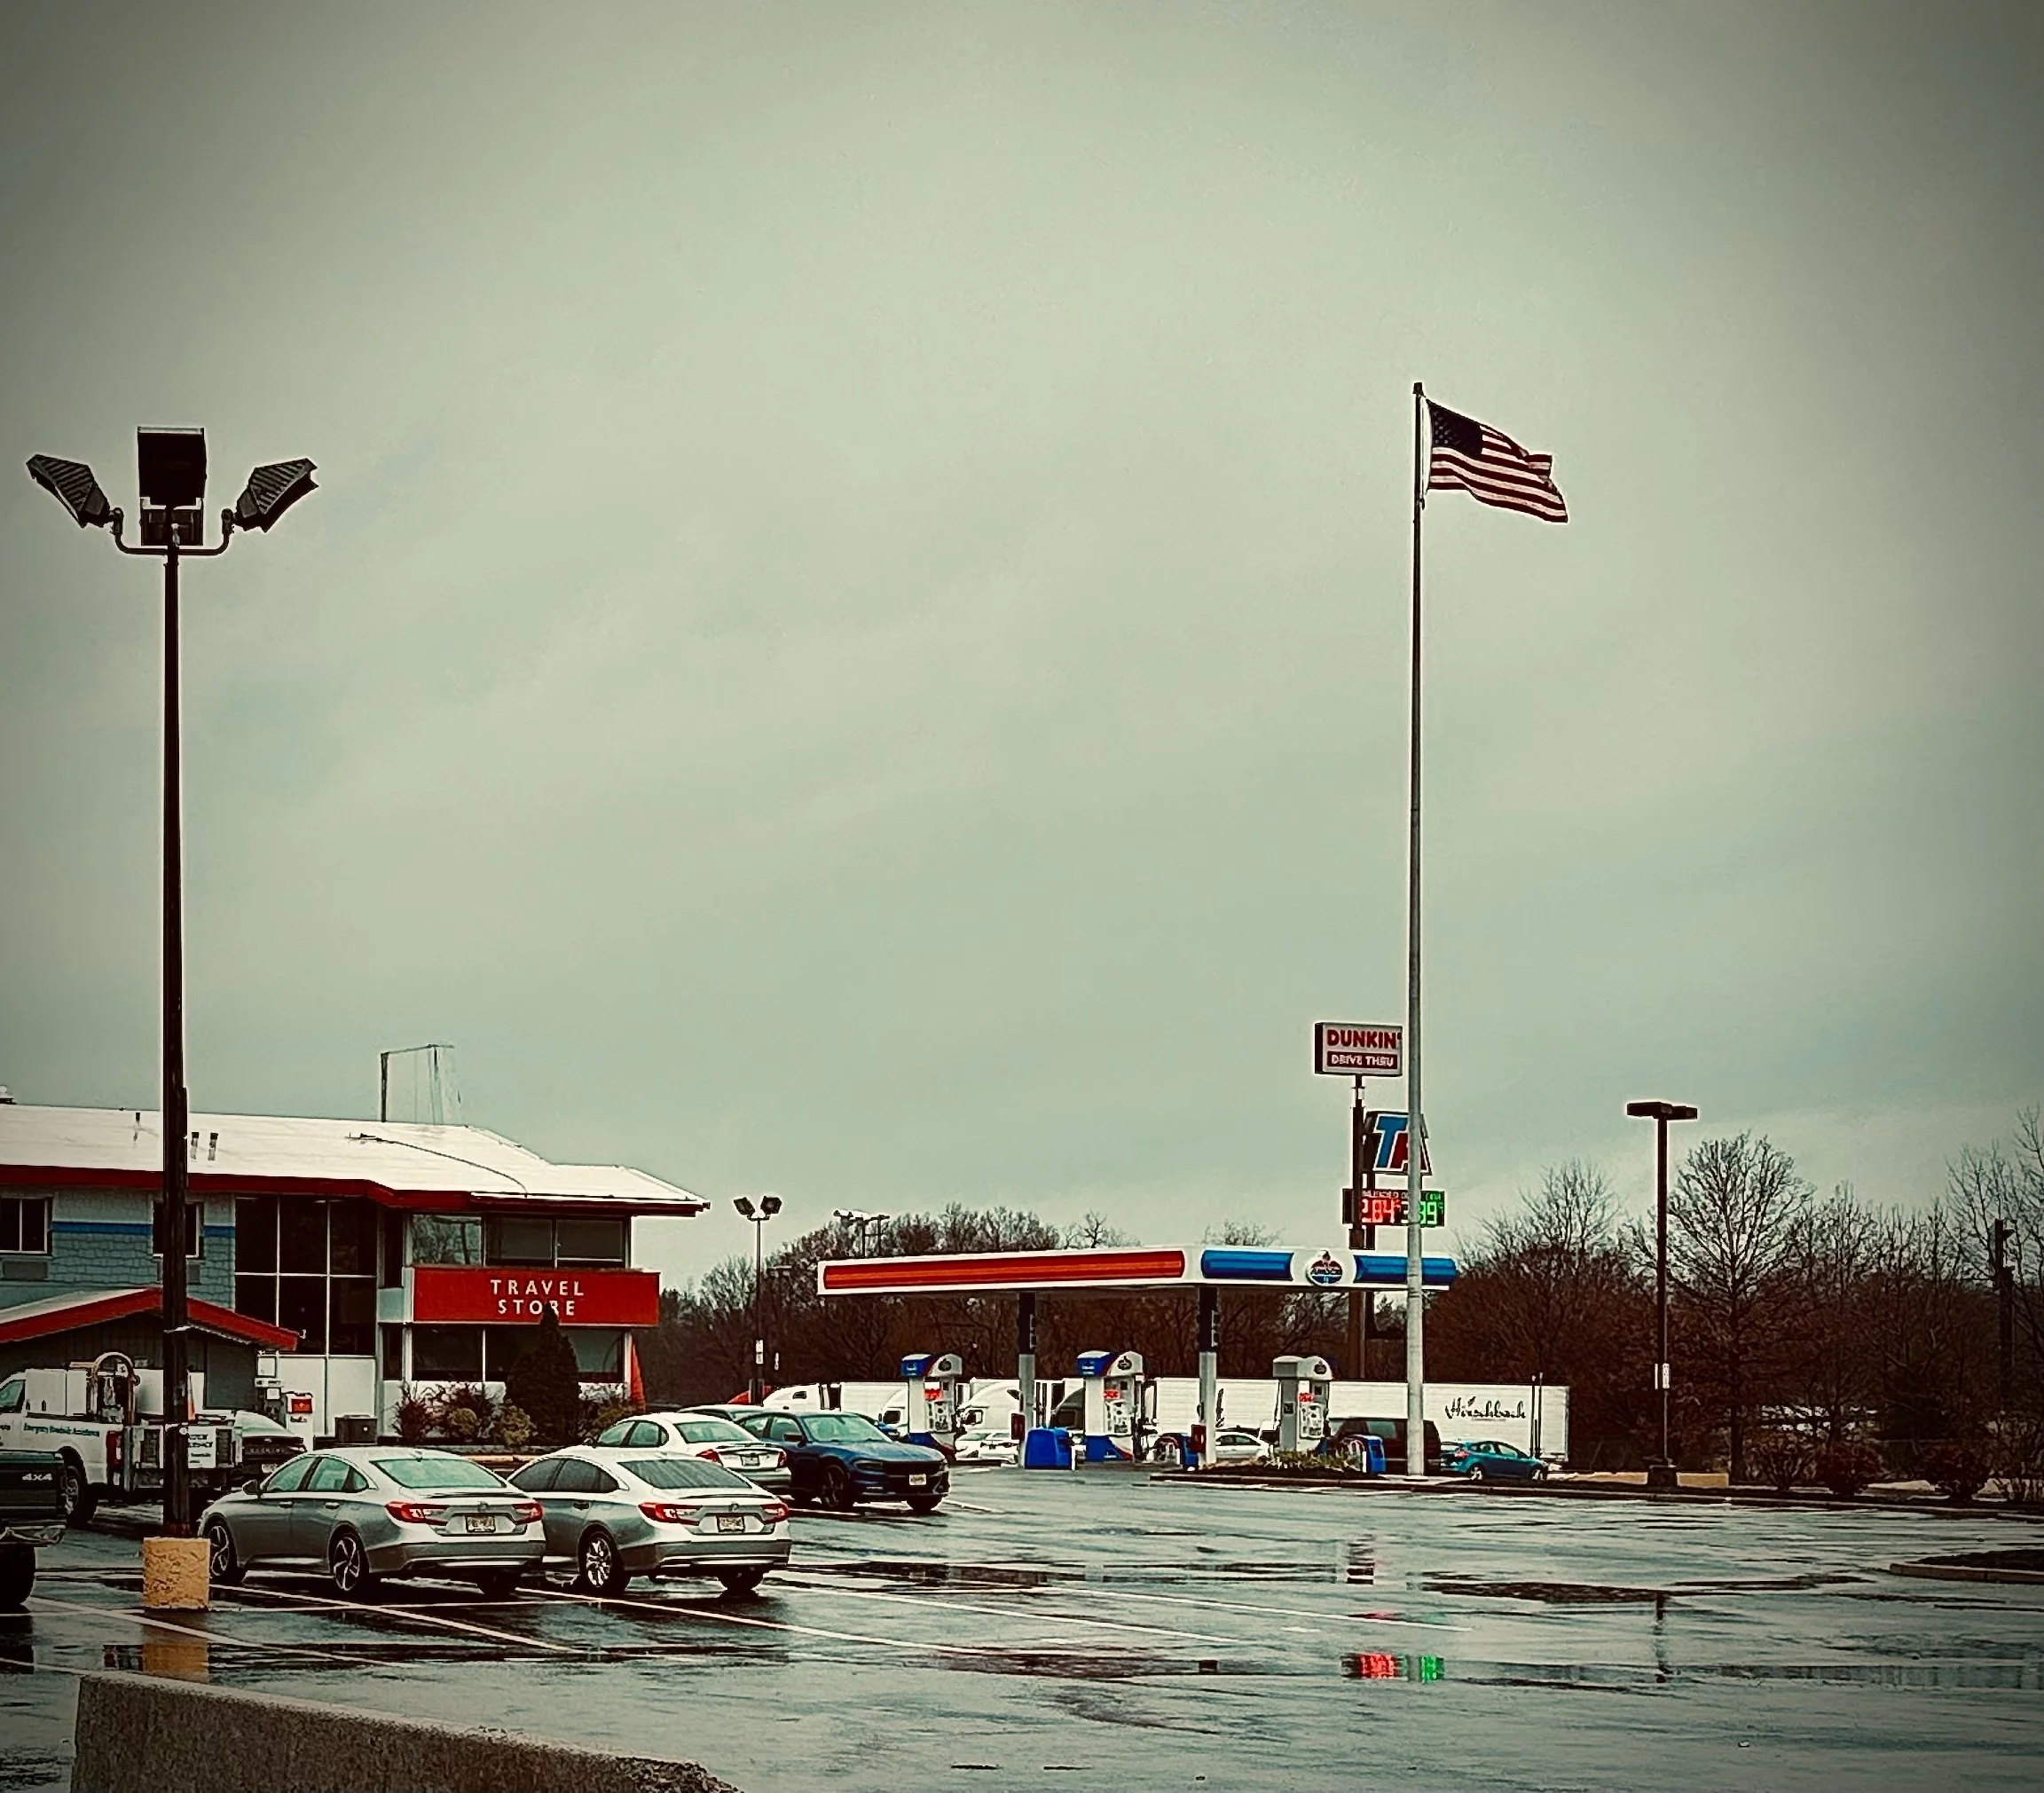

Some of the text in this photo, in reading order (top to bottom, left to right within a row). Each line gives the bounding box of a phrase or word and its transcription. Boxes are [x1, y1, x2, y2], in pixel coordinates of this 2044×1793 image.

[1326, 1029, 1403, 1050] DUNKIN'
[1331, 1054, 1394, 1067] DRIVE THRU
[490, 1279, 585, 1296] TRAVEL
[498, 1299, 575, 1316] STORE
